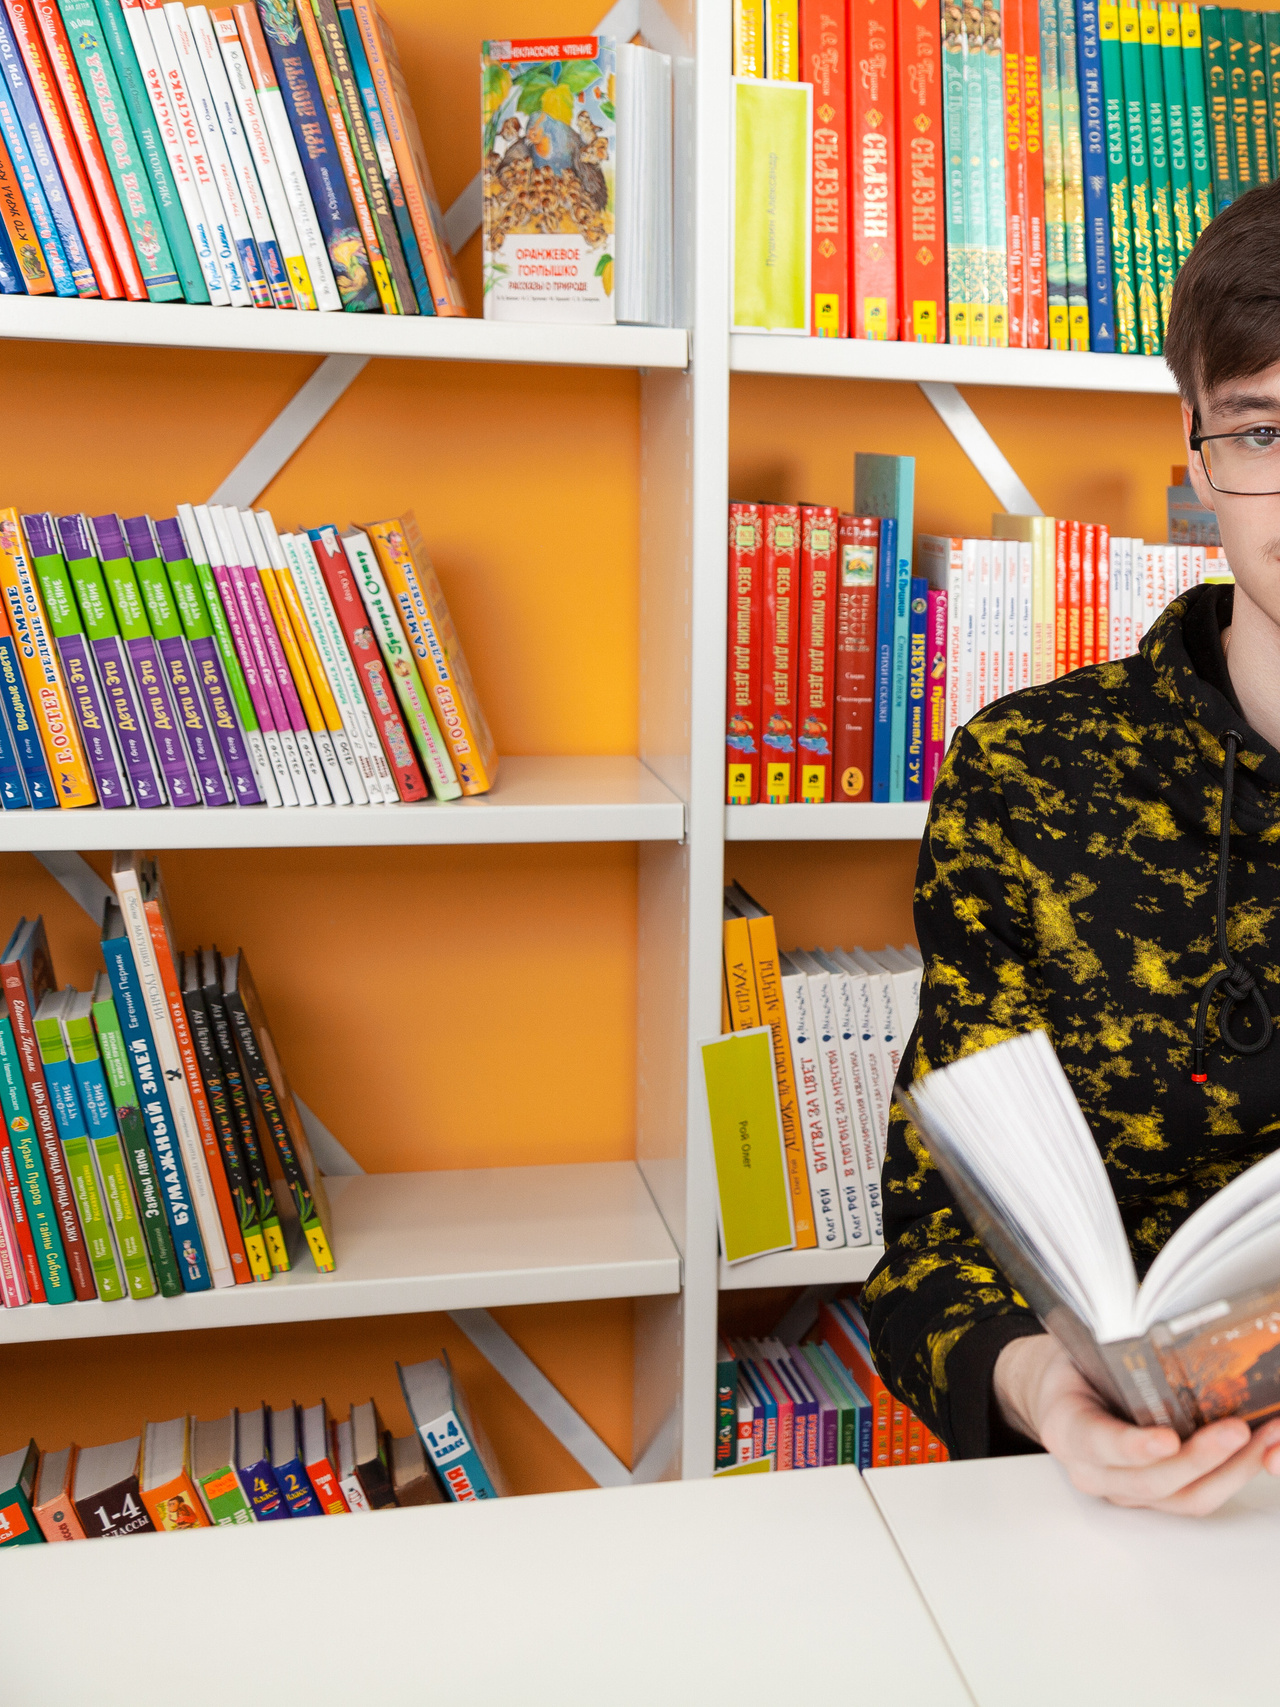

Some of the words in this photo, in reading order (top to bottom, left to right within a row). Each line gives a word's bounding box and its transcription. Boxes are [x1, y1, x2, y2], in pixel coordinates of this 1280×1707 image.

[325, 21, 349, 73] зверей
[1207, 35, 1222, 58] А.
[1229, 37, 1243, 60] А.
[1248, 40, 1262, 62] А.
[1209, 65, 1224, 87] С.
[1231, 67, 1245, 89] С.
[1249, 69, 1265, 91] С.
[84, 51, 132, 168] ТОЛСТЯКА
[340, 76, 375, 162] диковинных
[1106, 98, 1122, 164] СКАЗКИ
[1128, 100, 1144, 166] СКАЗКИ
[1150, 102, 1164, 168] СКАЗКИ
[1169, 104, 1185, 169] СКАЗКИ
[1191, 105, 1206, 170] СКАЗКИ
[1210, 95, 1229, 180] Пушкин
[1231, 97, 1250, 181] Пушкин
[1250, 99, 1269, 183] Пушкин
[120, 170, 147, 217] ТРИ
[365, 165, 390, 216] Азбука
[809, 127, 841, 234] СКАЗКИ
[858, 132, 890, 238] СКАЗКИ
[906, 136, 938, 242] СКАЗКИ
[1, 184, 21, 218] УКРАЛ
[12, 217, 29, 242] КТО
[515, 248, 579, 260] ОРАНЖЕВОЕ
[518, 264, 577, 276] ГОРЛЫШКО
[14, 553, 38, 613] СОВЕТЫ
[353, 548, 381, 596] Остер
[400, 562, 428, 616] СОВЕТЫ
[739, 566, 750, 593] ВЕСЬ
[777, 567, 790, 593] ВЕСЬ
[813, 570, 825, 596] ВЕСЬ
[51, 577, 71, 616] ЧТЕНИЕ
[86, 580, 105, 619] ЧТЕНИЕ
[123, 580, 142, 618] ЧТЕНИЕ
[152, 580, 172, 619] ЧТЕНИЕ
[182, 582, 202, 619] ЧТЕНИЕ
[5, 584, 35, 659] САМЫЕ
[371, 596, 404, 656] Григорий
[397, 591, 429, 659] САМЫЕ
[736, 595, 750, 643] ПУШКИН
[775, 596, 789, 643] ПУШКИН
[810, 599, 825, 646] ПУШКИН
[0, 644, 16, 684] советы
[30, 615, 57, 683] ВРЕДНЫЕ
[420, 618, 450, 681] ВРЕДНЫЕ
[735, 646, 749, 669] ДЛЯ
[775, 646, 787, 669] ДЛЯ
[809, 649, 823, 671] ДЛЯ
[879, 643, 888, 671] СТИХИ
[910, 633, 926, 699] СКАЗКИ
[67, 656, 86, 683] Эти
[102, 659, 121, 686] Эти
[138, 658, 157, 685] Эти
[167, 658, 187, 686] Эти
[198, 658, 218, 685] Эти
[734, 671, 749, 705] ДЕТЕЙ
[77, 684, 89, 694] и
[111, 686, 123, 696] и
[148, 685, 160, 695] и
[178, 685, 190, 695] и
[209, 684, 221, 695] и
[774, 672, 789, 705] ДЕТЕЙ
[808, 674, 823, 707] ДЕТЕЙ
[879, 683, 887, 721] СКАЗКИ
[6, 683, 30, 732] Вредные
[39, 685, 69, 748] ОСТЕР
[78, 694, 101, 731] Дети
[112, 696, 136, 733] Дети
[148, 695, 172, 732] Дети
[179, 694, 204, 732] Дети
[210, 694, 234, 731] Дети
[433, 681, 466, 741] ОСТЕР
[454, 738, 471, 755] Г.
[909, 706, 921, 753] Пушкин
[56, 746, 74, 764] Г.
[909, 758, 920, 783] А.С.
[112, 953, 129, 990] Пермяк
[132, 923, 153, 968] МАТУШКИ
[143, 972, 166, 1021] ГУСЫНИ
[730, 961, 753, 1012] СТРАХА
[12, 998, 29, 1035] Евгений
[121, 990, 139, 1029] Евгений
[170, 1001, 189, 1045] СКАЗОК
[20, 1035, 37, 1073] Пермяк
[127, 1037, 158, 1097] ЗМЕЙ
[183, 1047, 202, 1094] ЗИМНИХ
[824, 1049, 843, 1096] МЕЧТОЙ
[30, 1080, 46, 1105] ЦАРЬ
[799, 1056, 818, 1093] ЦВЕТ
[36, 1104, 52, 1132] ГОРОХ
[61, 1083, 77, 1119] ЧТЕНИЕ
[92, 1083, 108, 1118] ЧТЕНИЕ
[805, 1096, 820, 1117] ЗА
[833, 1096, 846, 1113] ЗА
[42, 1131, 54, 1139] И
[737, 1120, 750, 1140] Рой
[807, 1119, 830, 1173] БИТВА
[835, 1115, 854, 1165] ПОГОНЕ
[855, 1097, 876, 1170] ПРИКЛЮЧЕНИЯ
[18, 1137, 38, 1170] Кузька
[44, 1139, 62, 1174] ЦАРИЦА
[133, 1148, 149, 1176] лапы
[142, 1100, 190, 1227] БУМАЖНЫЙ
[740, 1143, 754, 1168] Олег
[24, 1170, 46, 1206] Пуаров
[844, 1168, 855, 1177] В
[52, 1174, 70, 1210] КУРИЦА.
[138, 1176, 160, 1218] Заячьи
[816, 1187, 833, 1213] РОЙ
[842, 1185, 858, 1211] РОЙ
[865, 1182, 881, 1208] РОЙ
[37, 1221, 54, 1250] тайны
[61, 1209, 78, 1242] СКАЗКИ
[823, 1216, 837, 1241] Олег
[849, 1214, 863, 1238] Олег
[43, 1252, 64, 1289] Сибири
[426, 1420, 459, 1448] 1-4
[254, 1477, 269, 1492] 4
[285, 1473, 300, 1490] 2
[94, 1493, 142, 1531] 1-4
